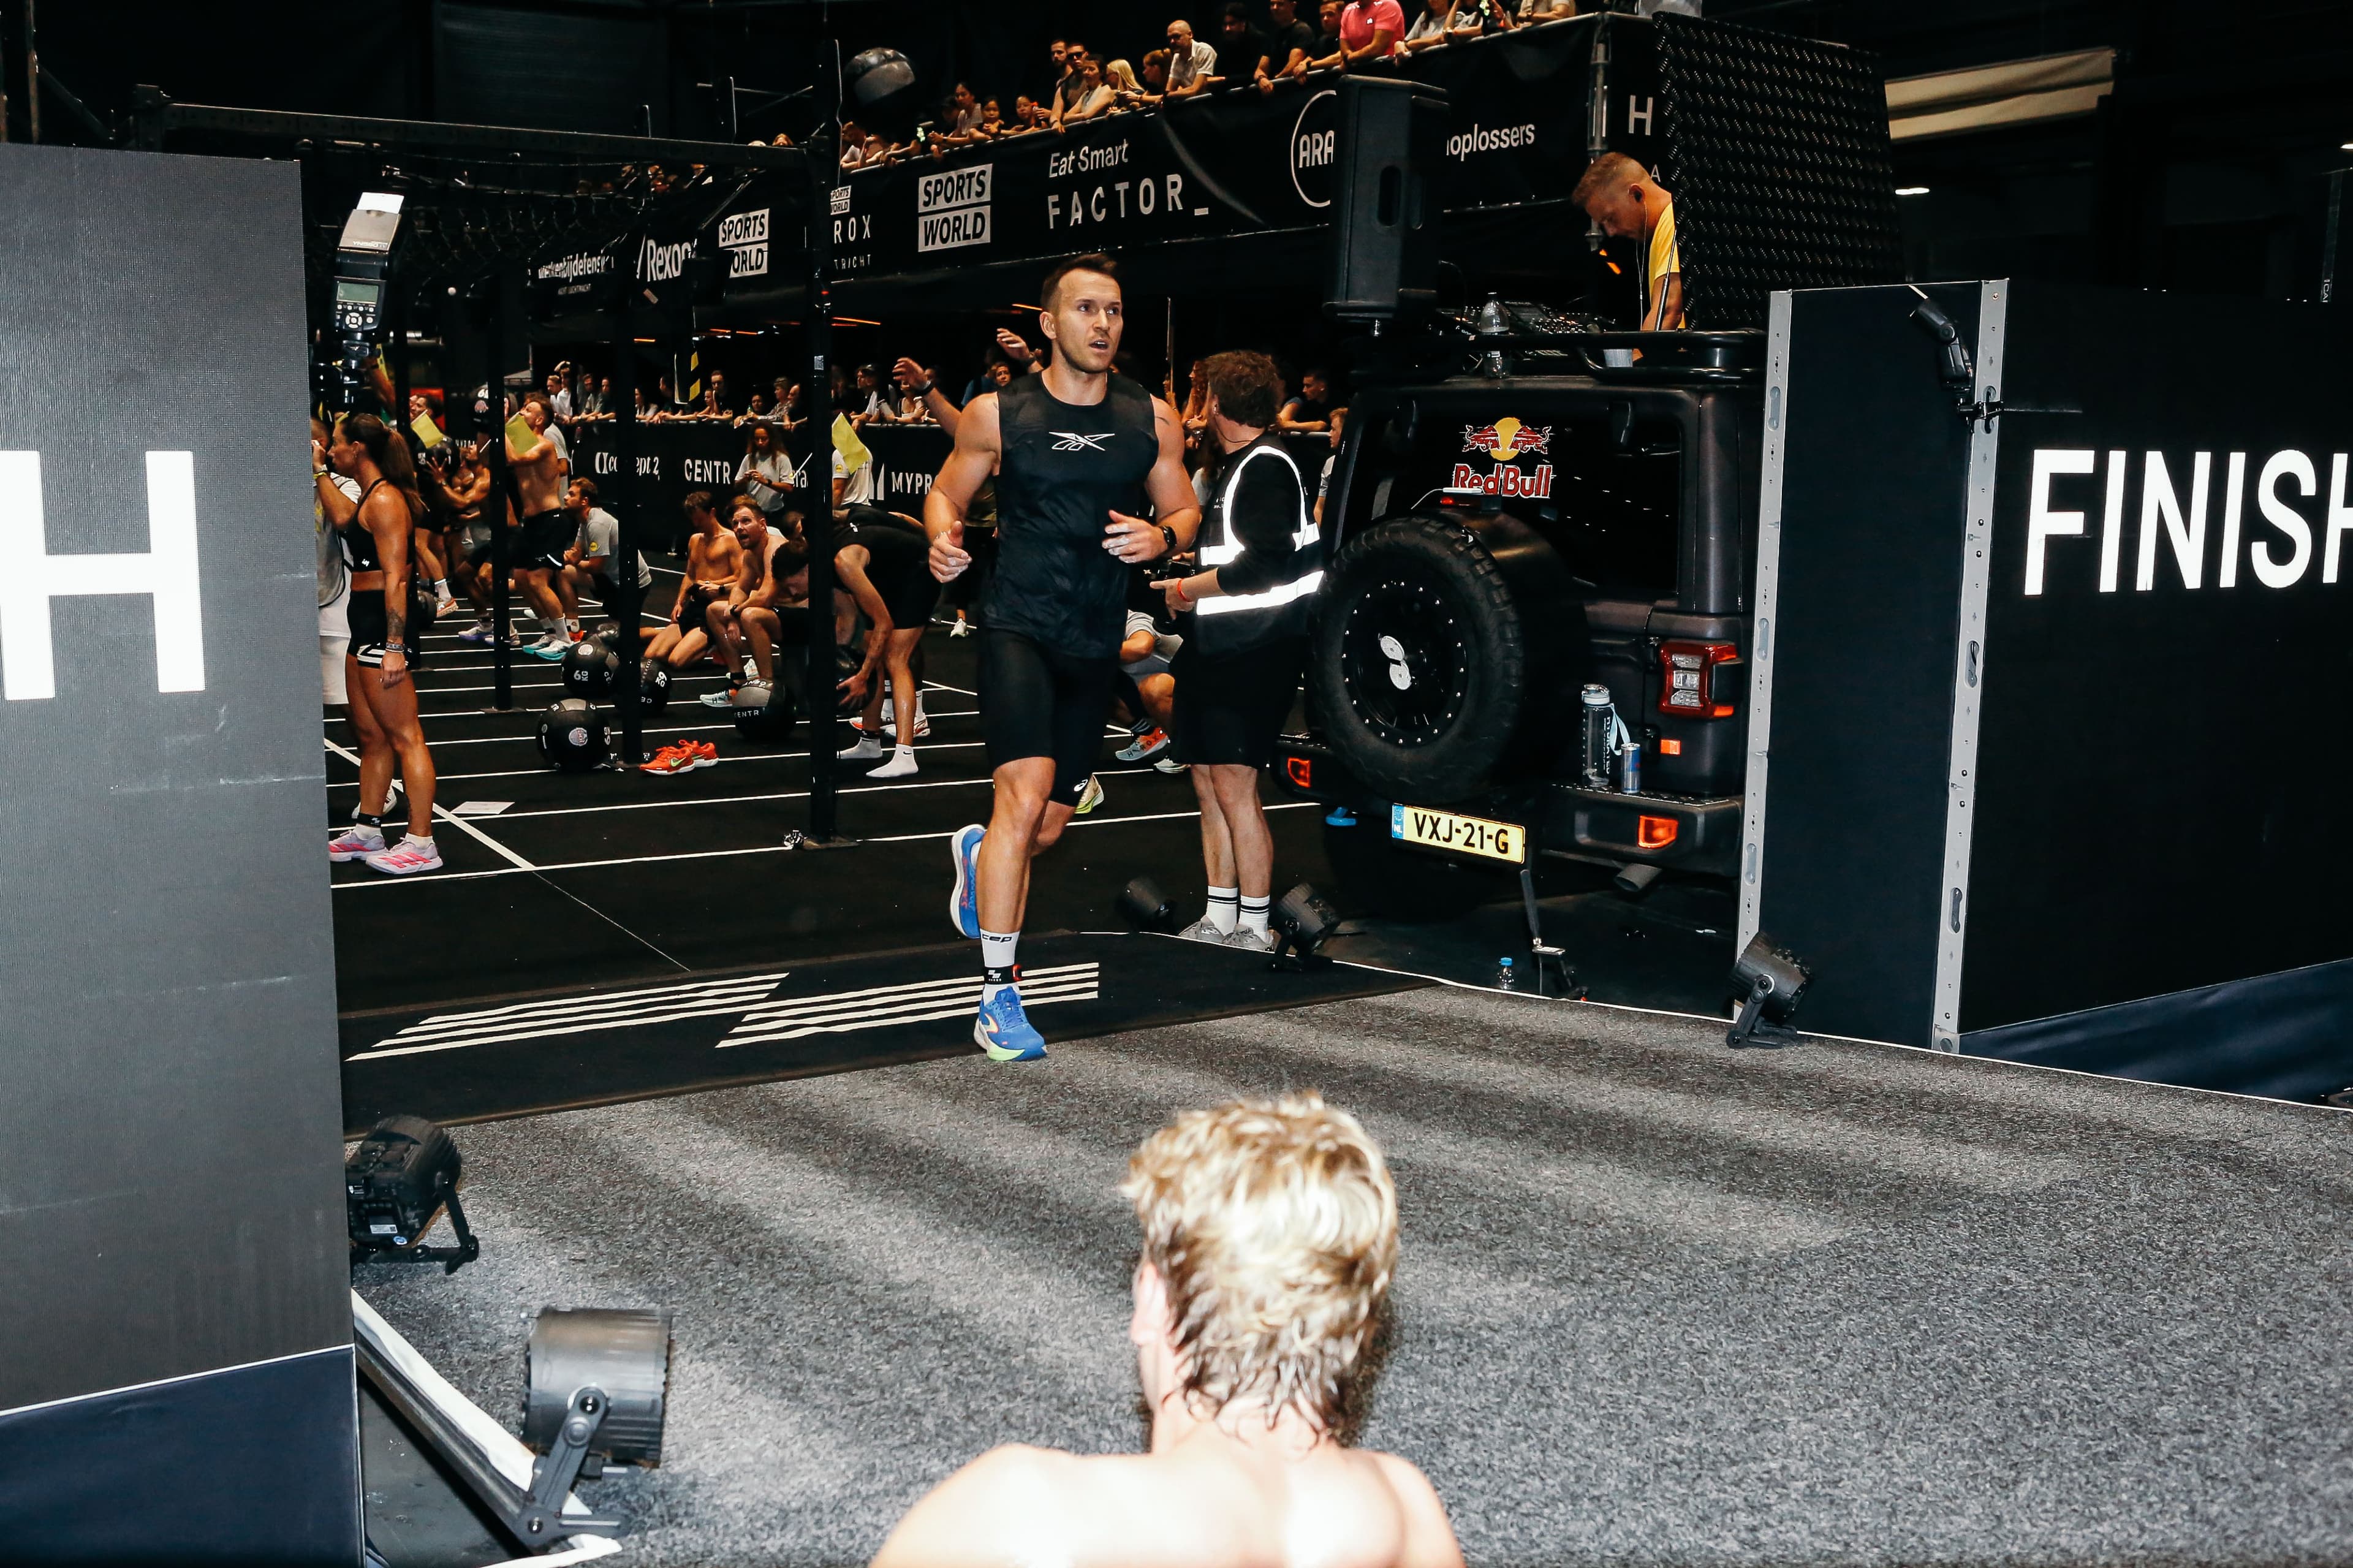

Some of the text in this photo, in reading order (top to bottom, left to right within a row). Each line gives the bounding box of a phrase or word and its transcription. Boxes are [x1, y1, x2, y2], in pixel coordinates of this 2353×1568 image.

[1048, 138, 1129, 178] Eat Smart
[1299, 130, 1335, 168] ARA
[831, 187, 849, 199] PORTS
[923, 169, 987, 208] SPORTS
[832, 202, 849, 212] ORLD
[722, 214, 765, 243] SPORTS
[834, 214, 870, 244] ROX
[924, 211, 986, 246] WORLD
[732, 248, 764, 273] ORLD
[834, 254, 871, 270] TRICHT
[684, 458, 731, 485] CENTR
[892, 471, 934, 495] MYPR
[1452, 463, 1553, 498] Red Bull
[1414, 812, 1509, 854] VXJ-21-G
[982, 934, 1012, 943] cep
